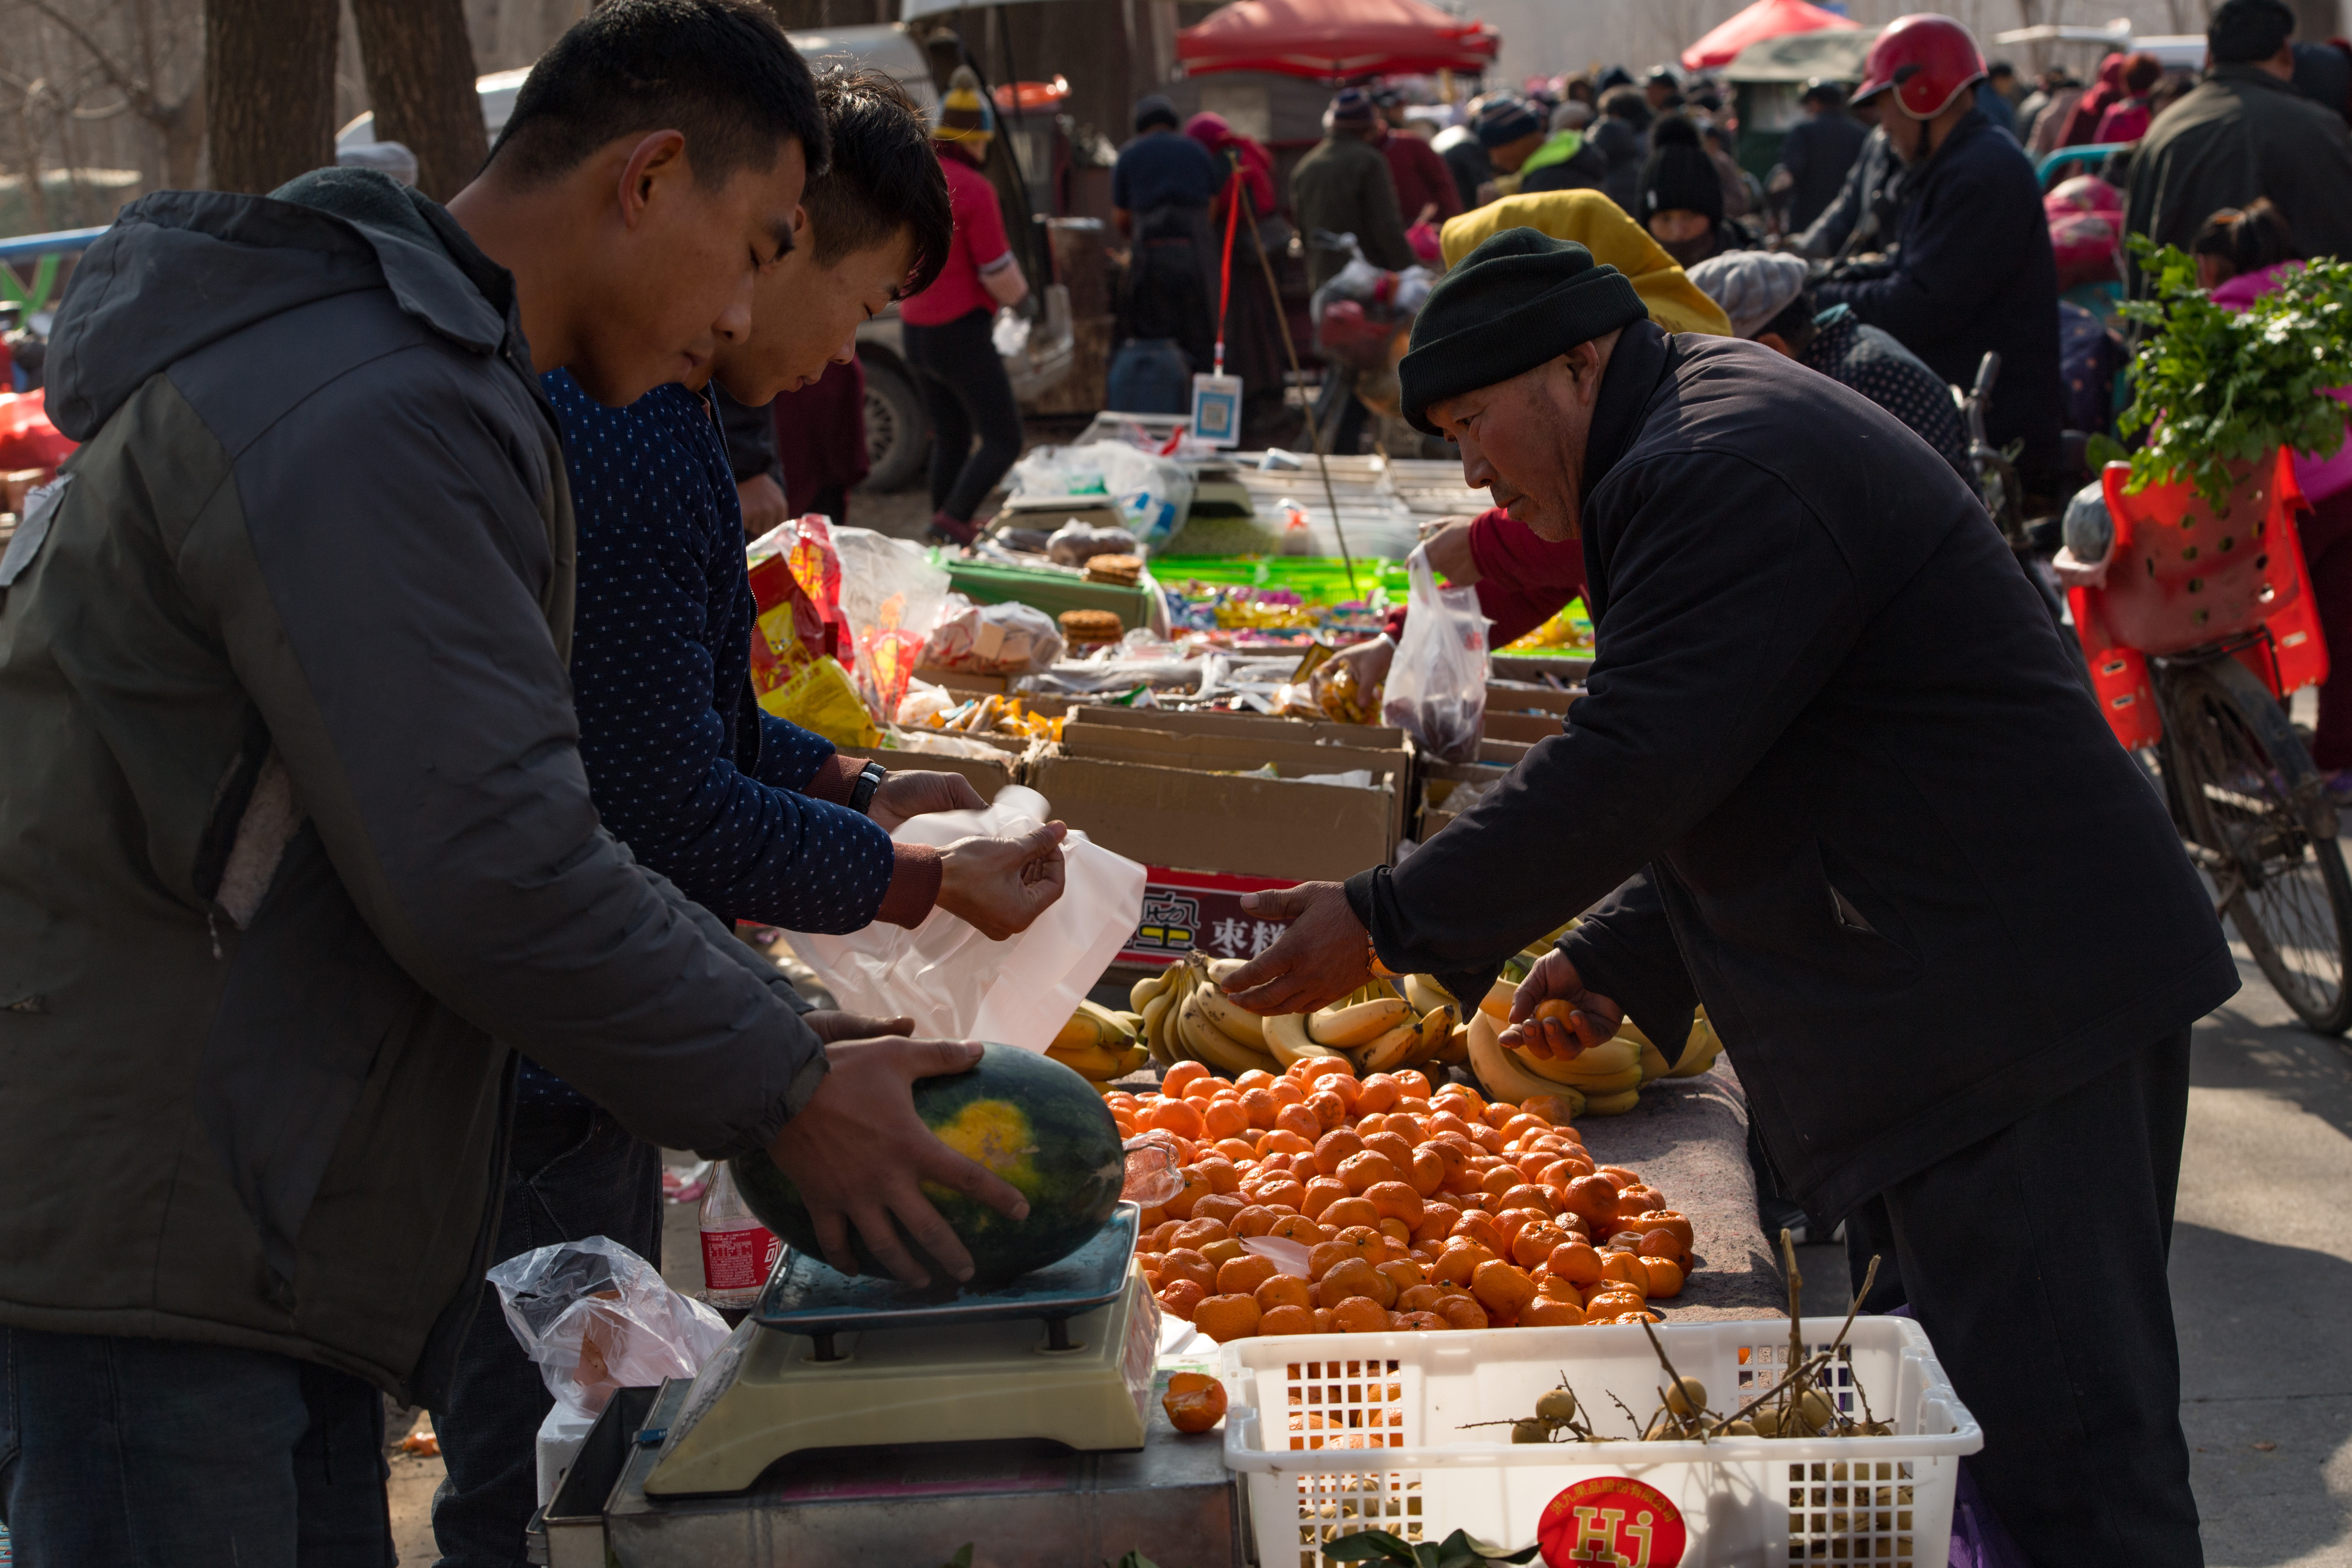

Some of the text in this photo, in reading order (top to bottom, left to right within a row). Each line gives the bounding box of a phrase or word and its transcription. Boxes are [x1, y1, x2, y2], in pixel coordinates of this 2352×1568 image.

[1549, 1478, 1678, 1523] 洪九果品股份有限公司
